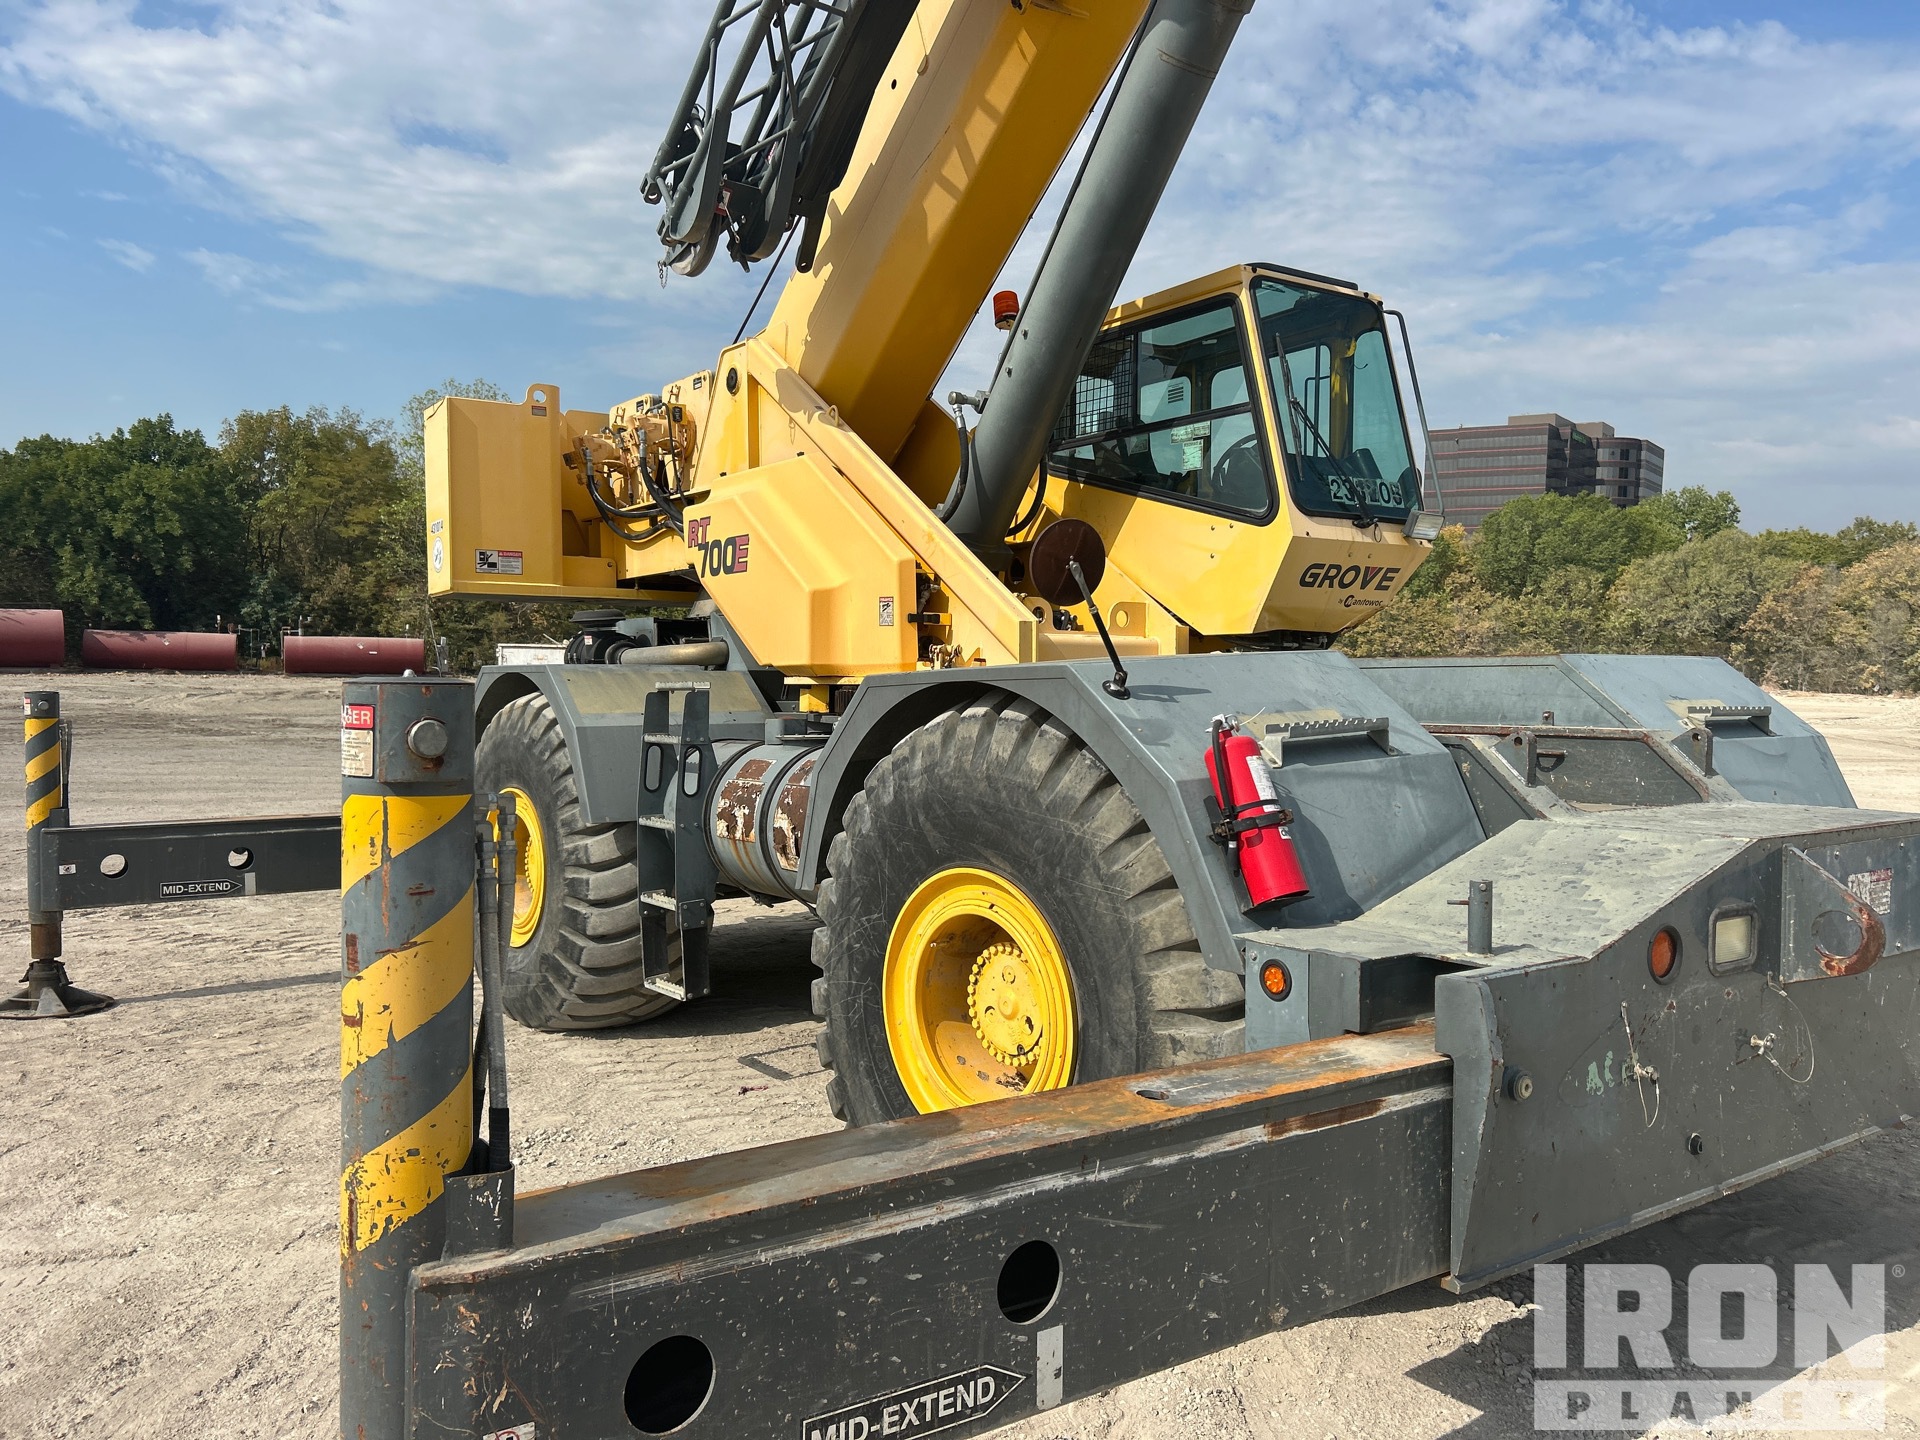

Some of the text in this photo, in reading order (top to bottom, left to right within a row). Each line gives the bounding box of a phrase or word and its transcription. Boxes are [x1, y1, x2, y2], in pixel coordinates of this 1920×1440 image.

[688, 516, 711, 548] RT
[698, 534, 749, 578] 700E
[1299, 563, 1401, 591] GROVE
[163, 882, 231, 894] MID-EXTEND
